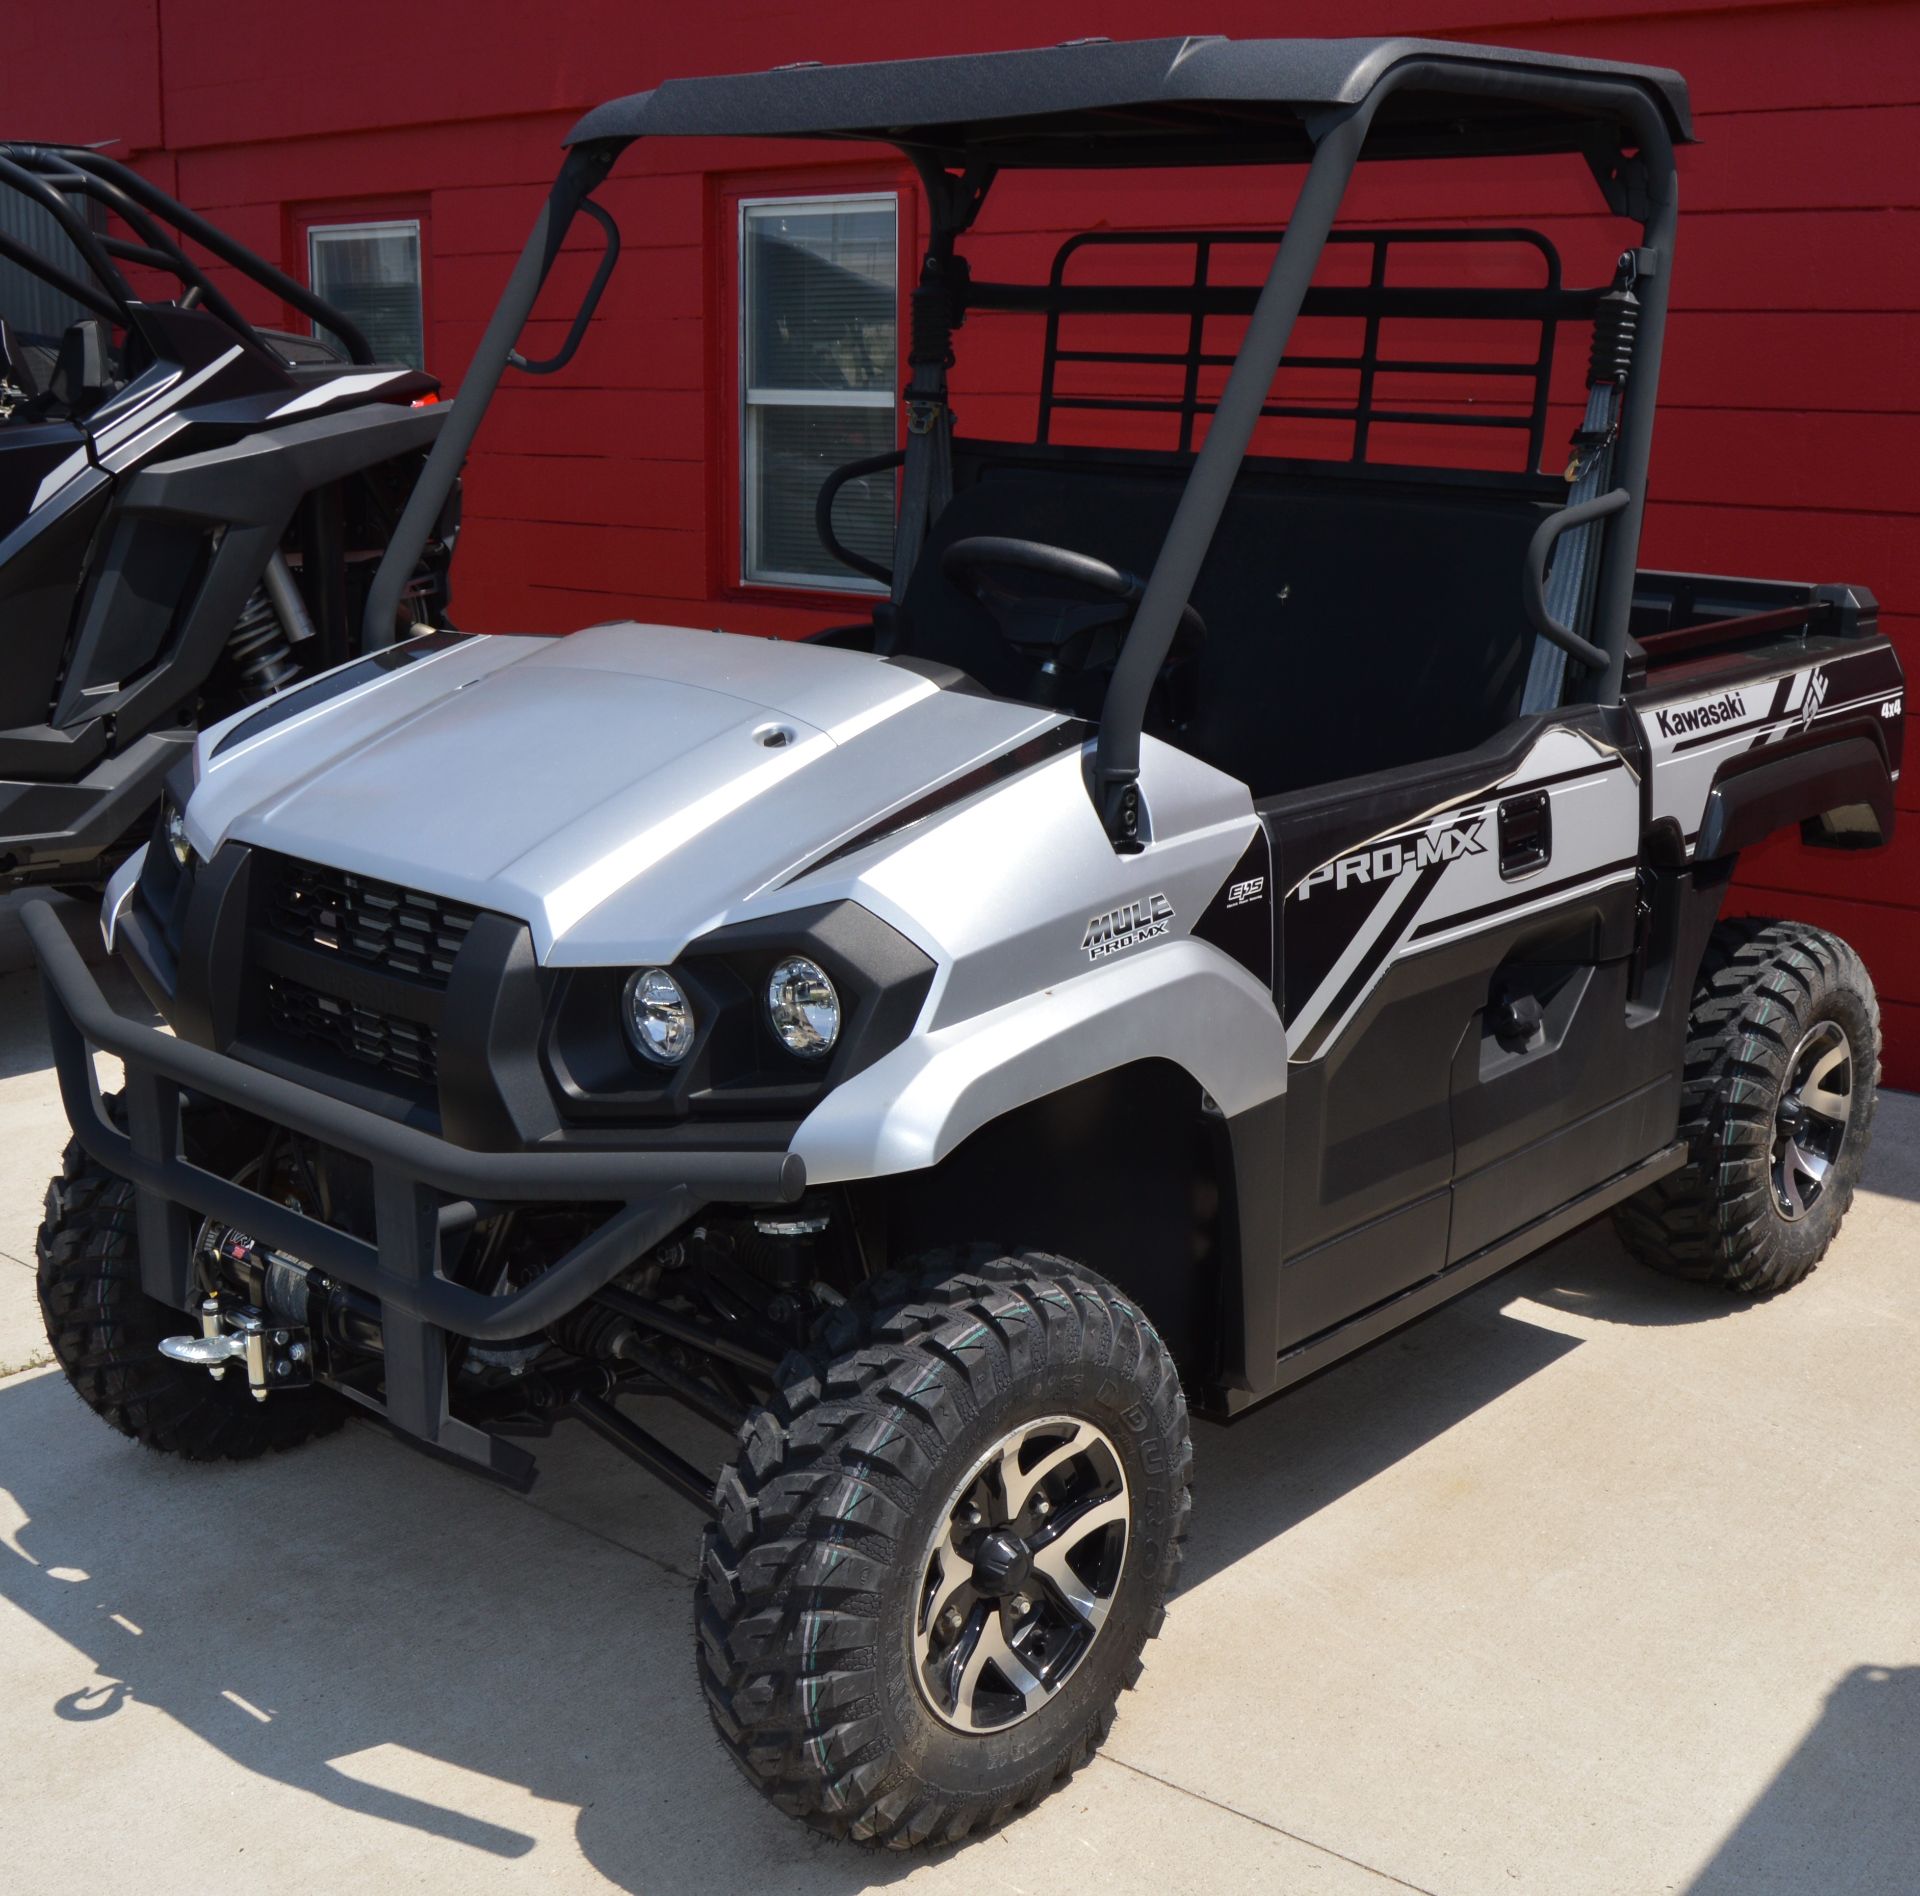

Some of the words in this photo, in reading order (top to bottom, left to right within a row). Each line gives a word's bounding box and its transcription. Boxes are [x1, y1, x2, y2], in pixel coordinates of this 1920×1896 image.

[1655, 691, 1747, 739] Kawasaki
[1881, 698, 1902, 718] 4x4
[1298, 821, 1489, 902] PRO-MX
[1080, 892, 1175, 950] MULE
[1088, 919, 1170, 962] PRO-MX
